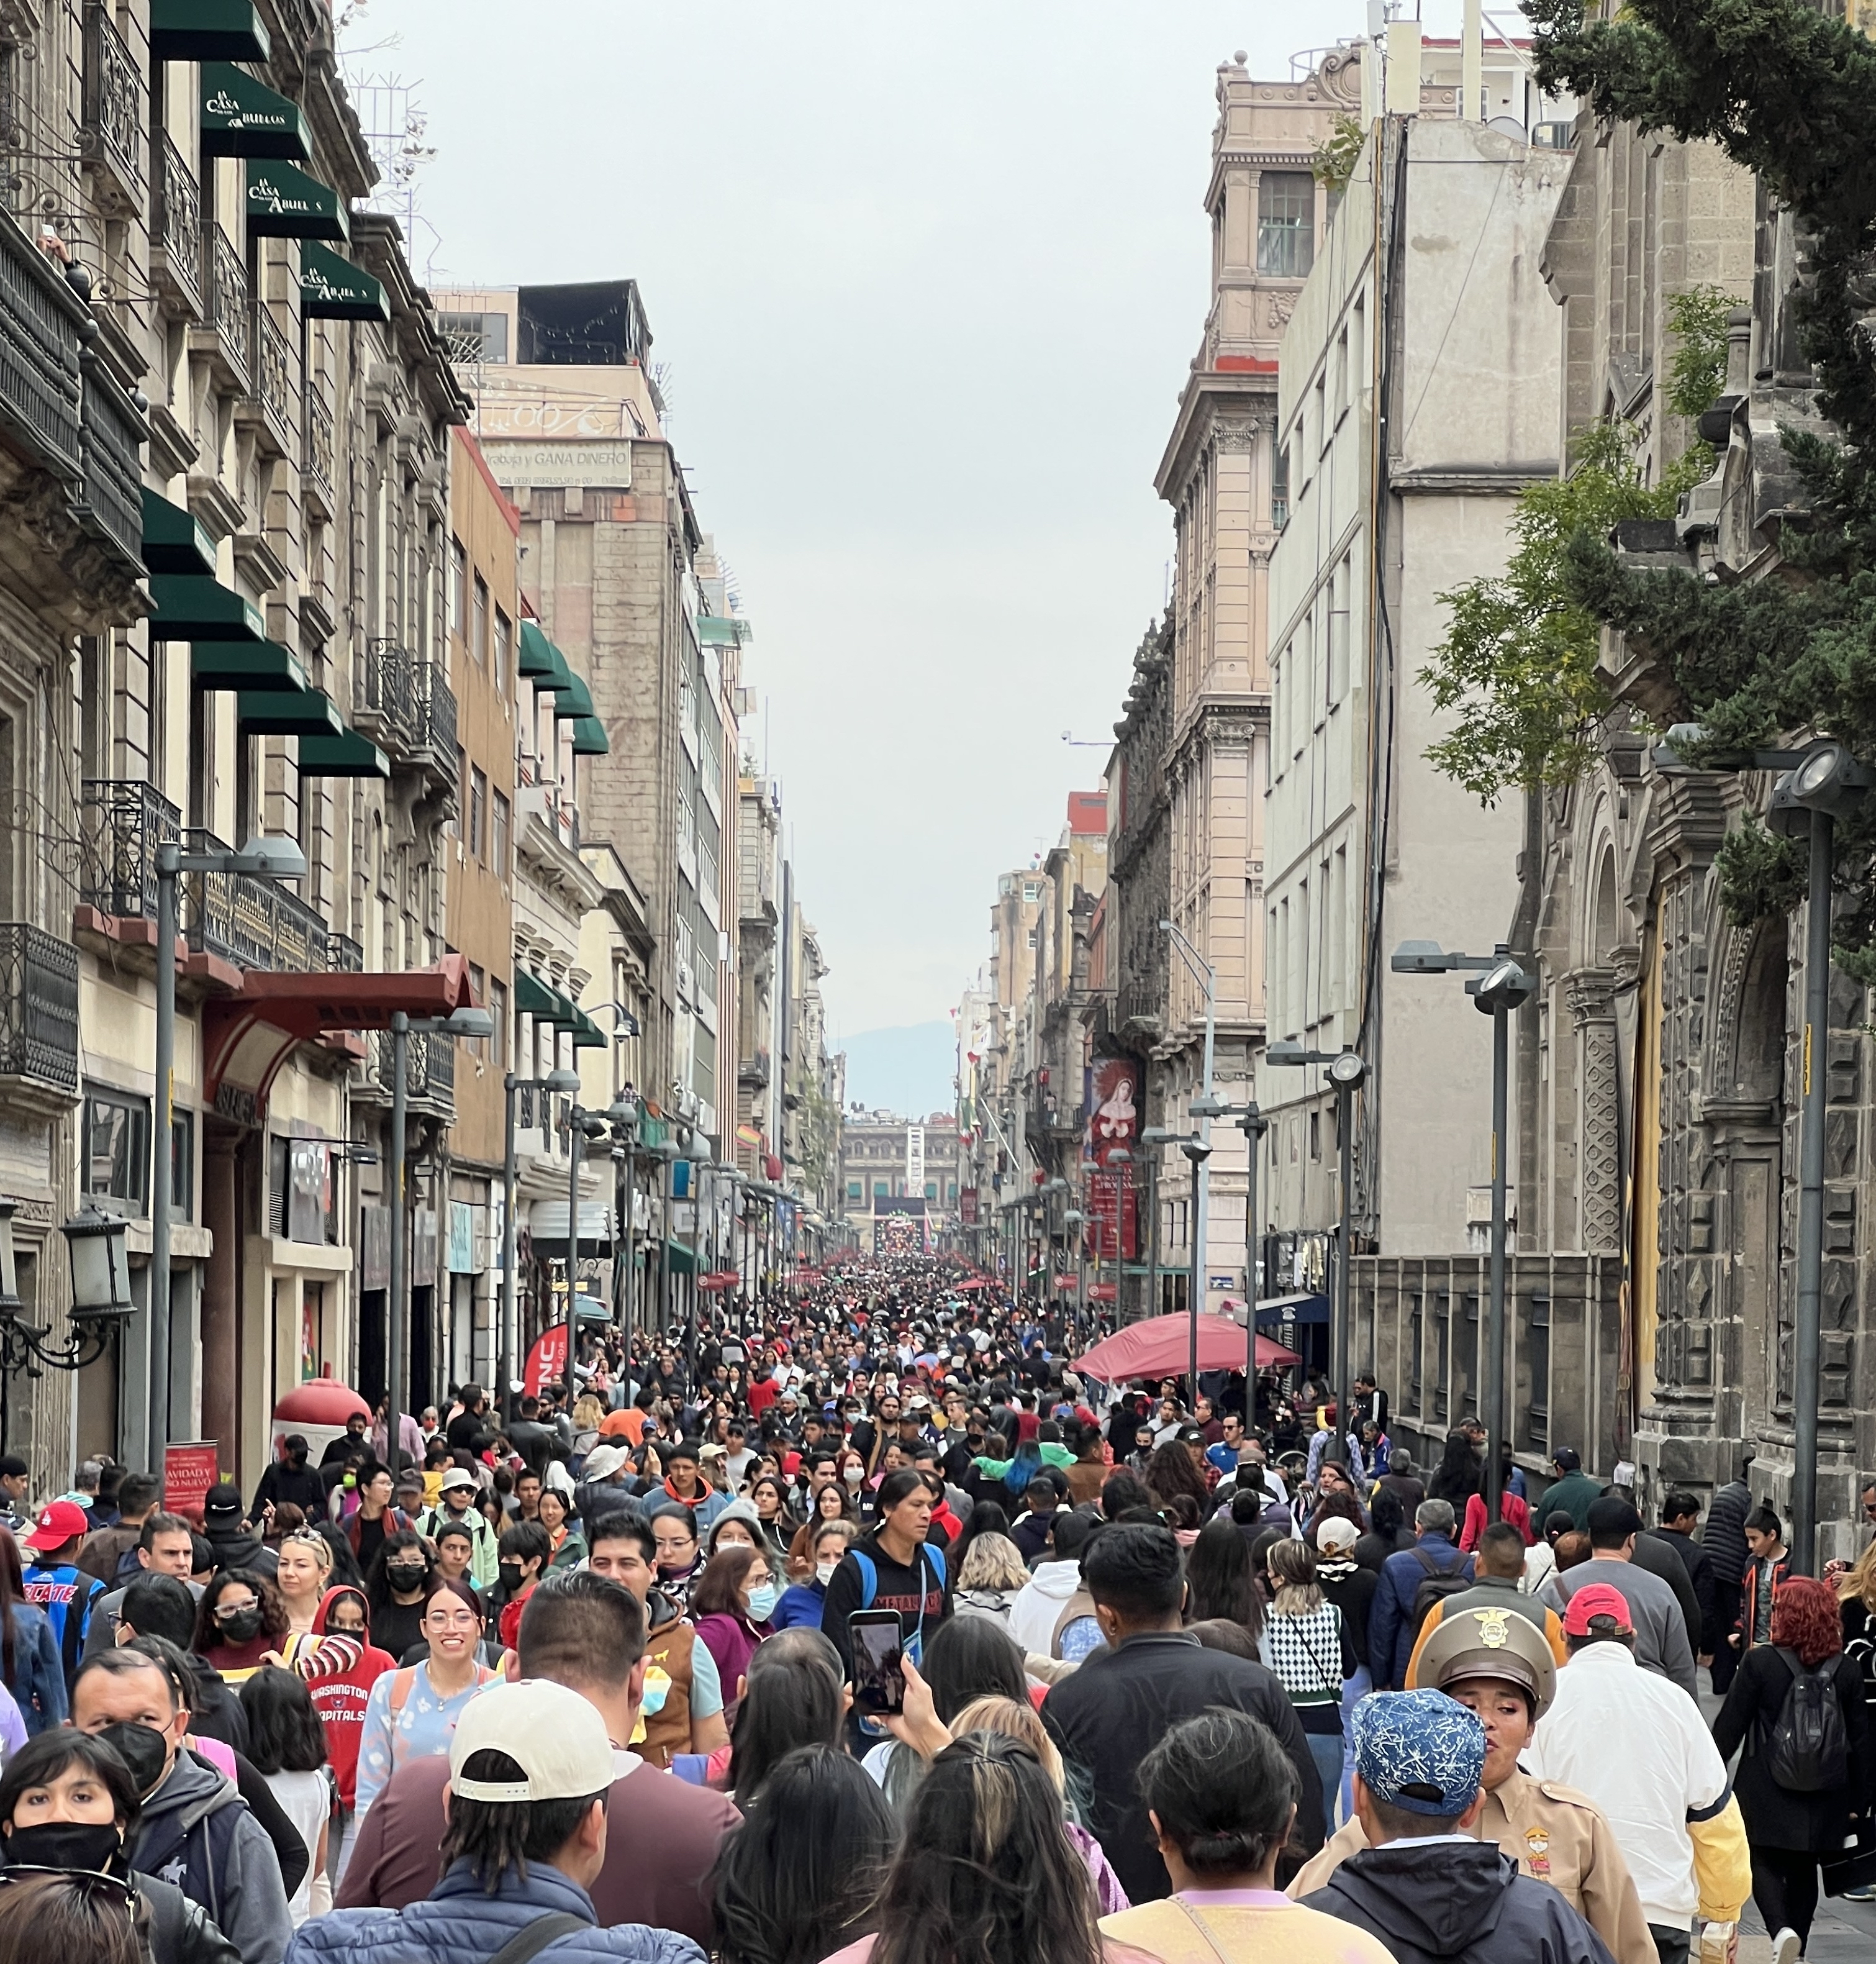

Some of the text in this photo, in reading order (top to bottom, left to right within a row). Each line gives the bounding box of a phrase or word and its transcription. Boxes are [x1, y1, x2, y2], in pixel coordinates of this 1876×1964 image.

[206, 99, 240, 113] CASA
[248, 186, 280, 199] CASA
[535, 452, 573, 465] GANA
[577, 452, 626, 465] DINERO
[166, 1468, 203, 1480] AVIDAD
[311, 1684, 368, 1701] WASHINGTON
[319, 1709, 365, 1722] APITALS
